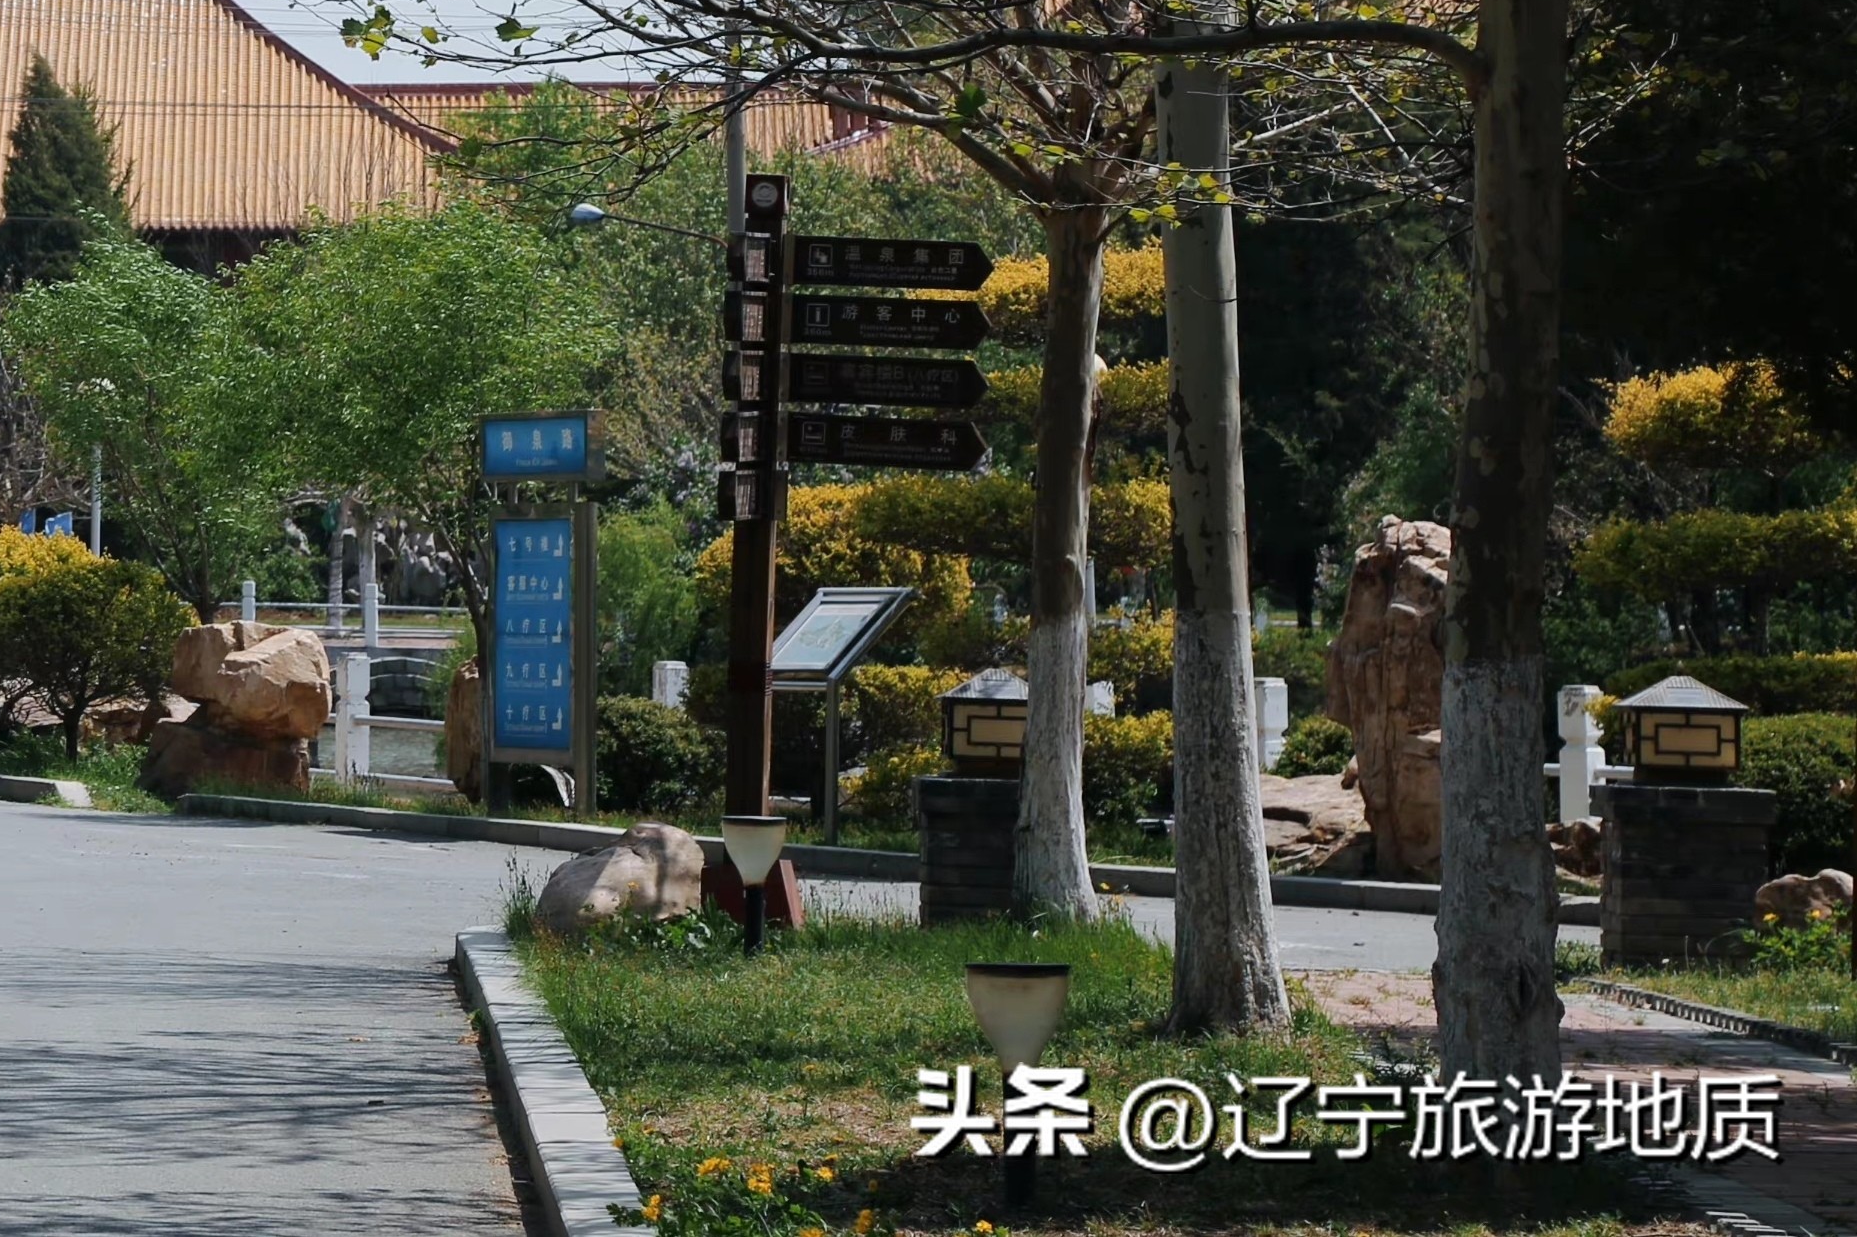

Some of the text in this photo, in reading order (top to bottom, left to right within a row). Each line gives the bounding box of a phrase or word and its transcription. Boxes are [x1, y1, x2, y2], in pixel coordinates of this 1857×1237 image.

[844, 244, 964, 266] 温泉集团
[841, 304, 961, 325] 游客中心
[840, 423, 958, 445] 皮肤科
[505, 618, 547, 635] 八疗区
[505, 662, 547, 679] 九疗区
